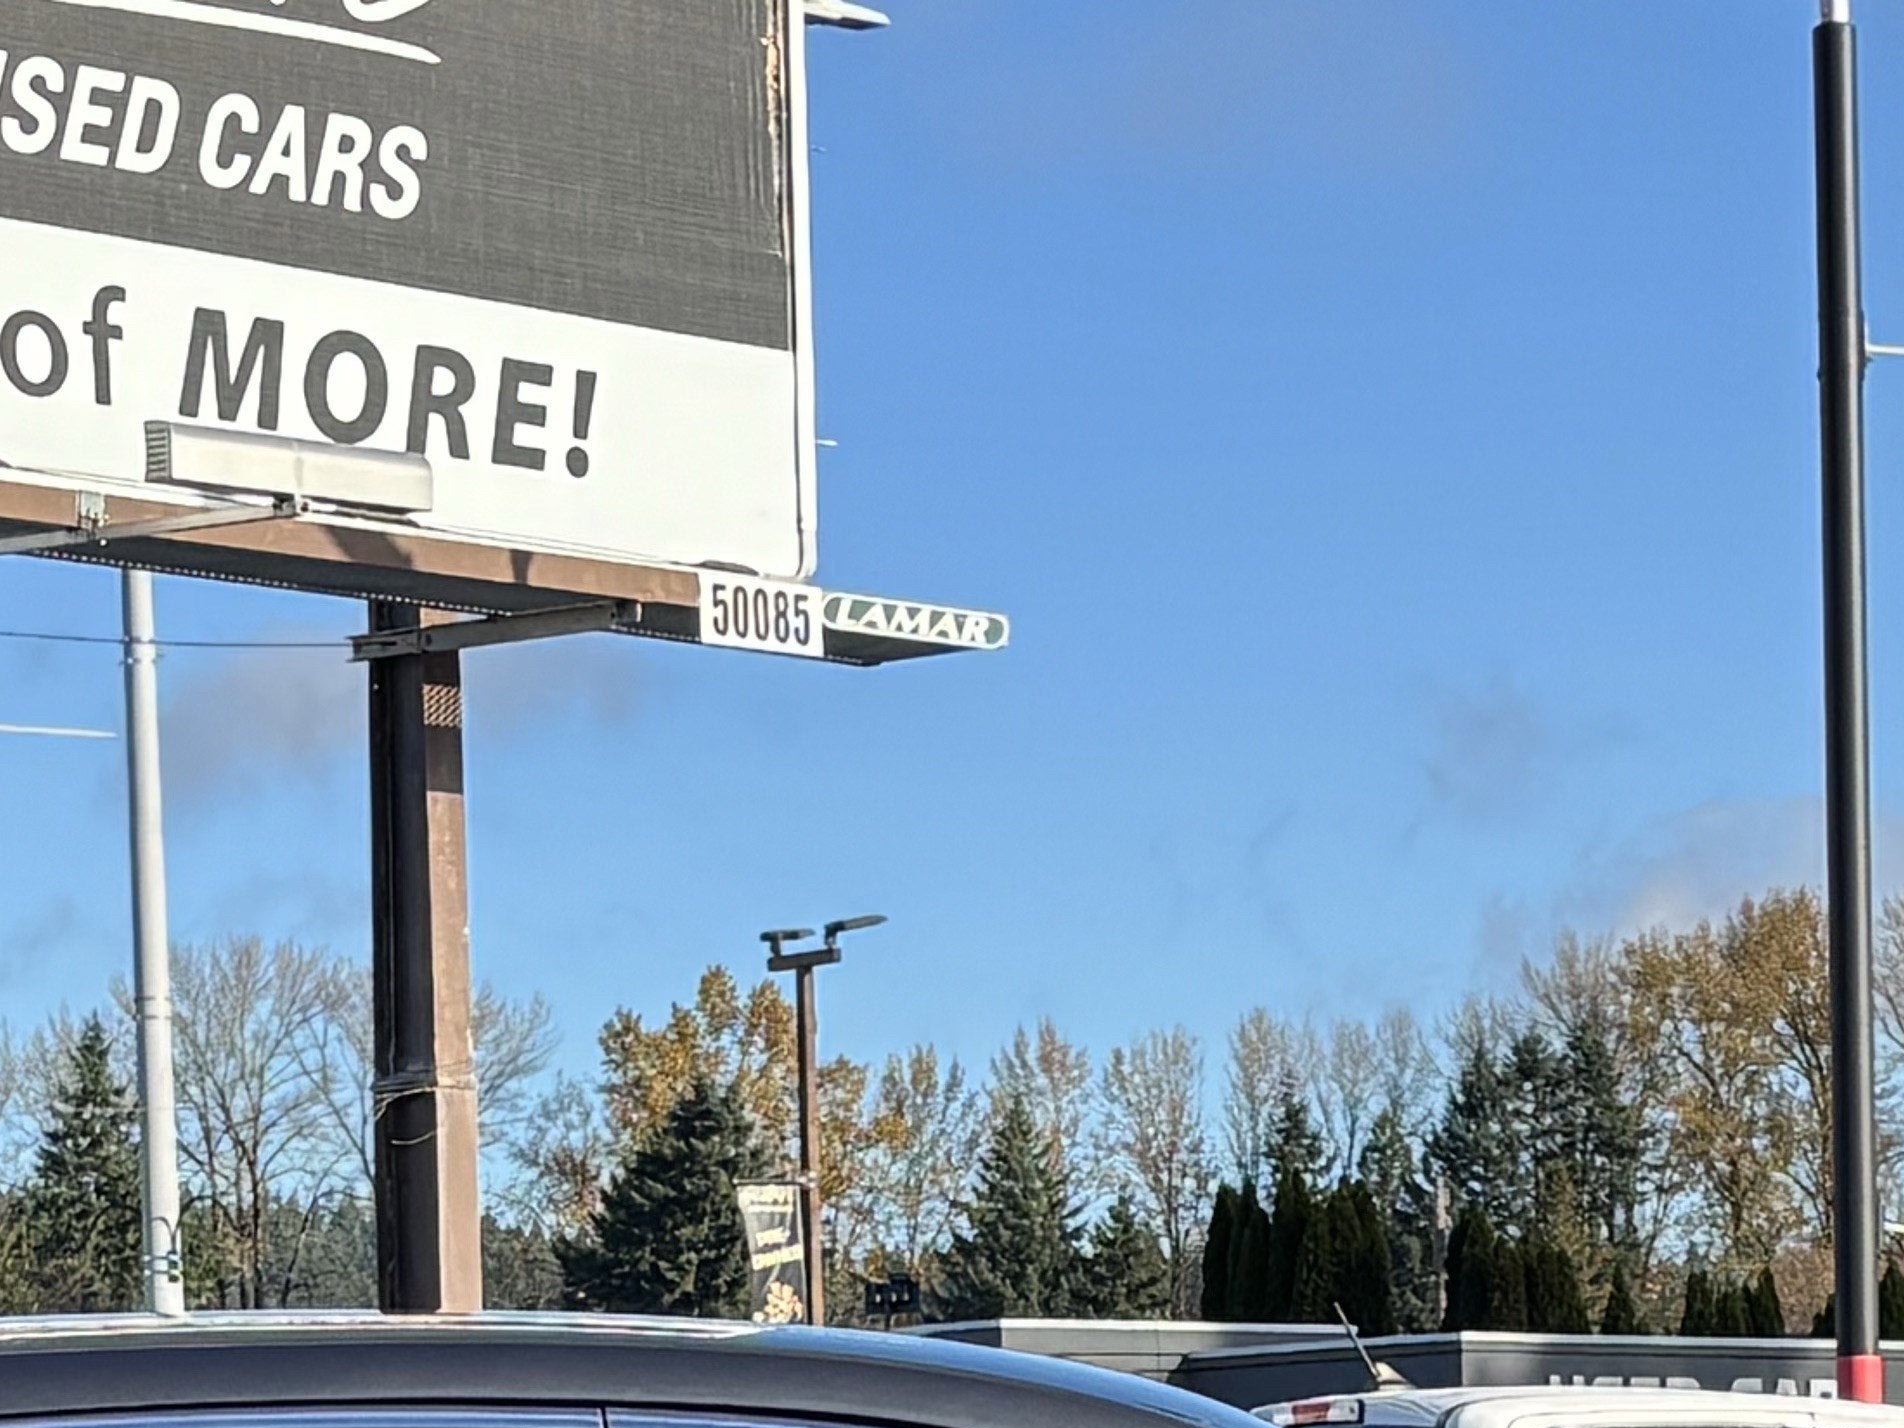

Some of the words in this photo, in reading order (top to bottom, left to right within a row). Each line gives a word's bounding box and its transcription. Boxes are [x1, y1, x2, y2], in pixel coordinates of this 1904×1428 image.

[199, 92, 429, 219] CARS
[0, 285, 127, 406] of
[178, 306, 597, 478] MORE!
[712, 583, 809, 646] 50085
[834, 599, 989, 643] LAMAR
